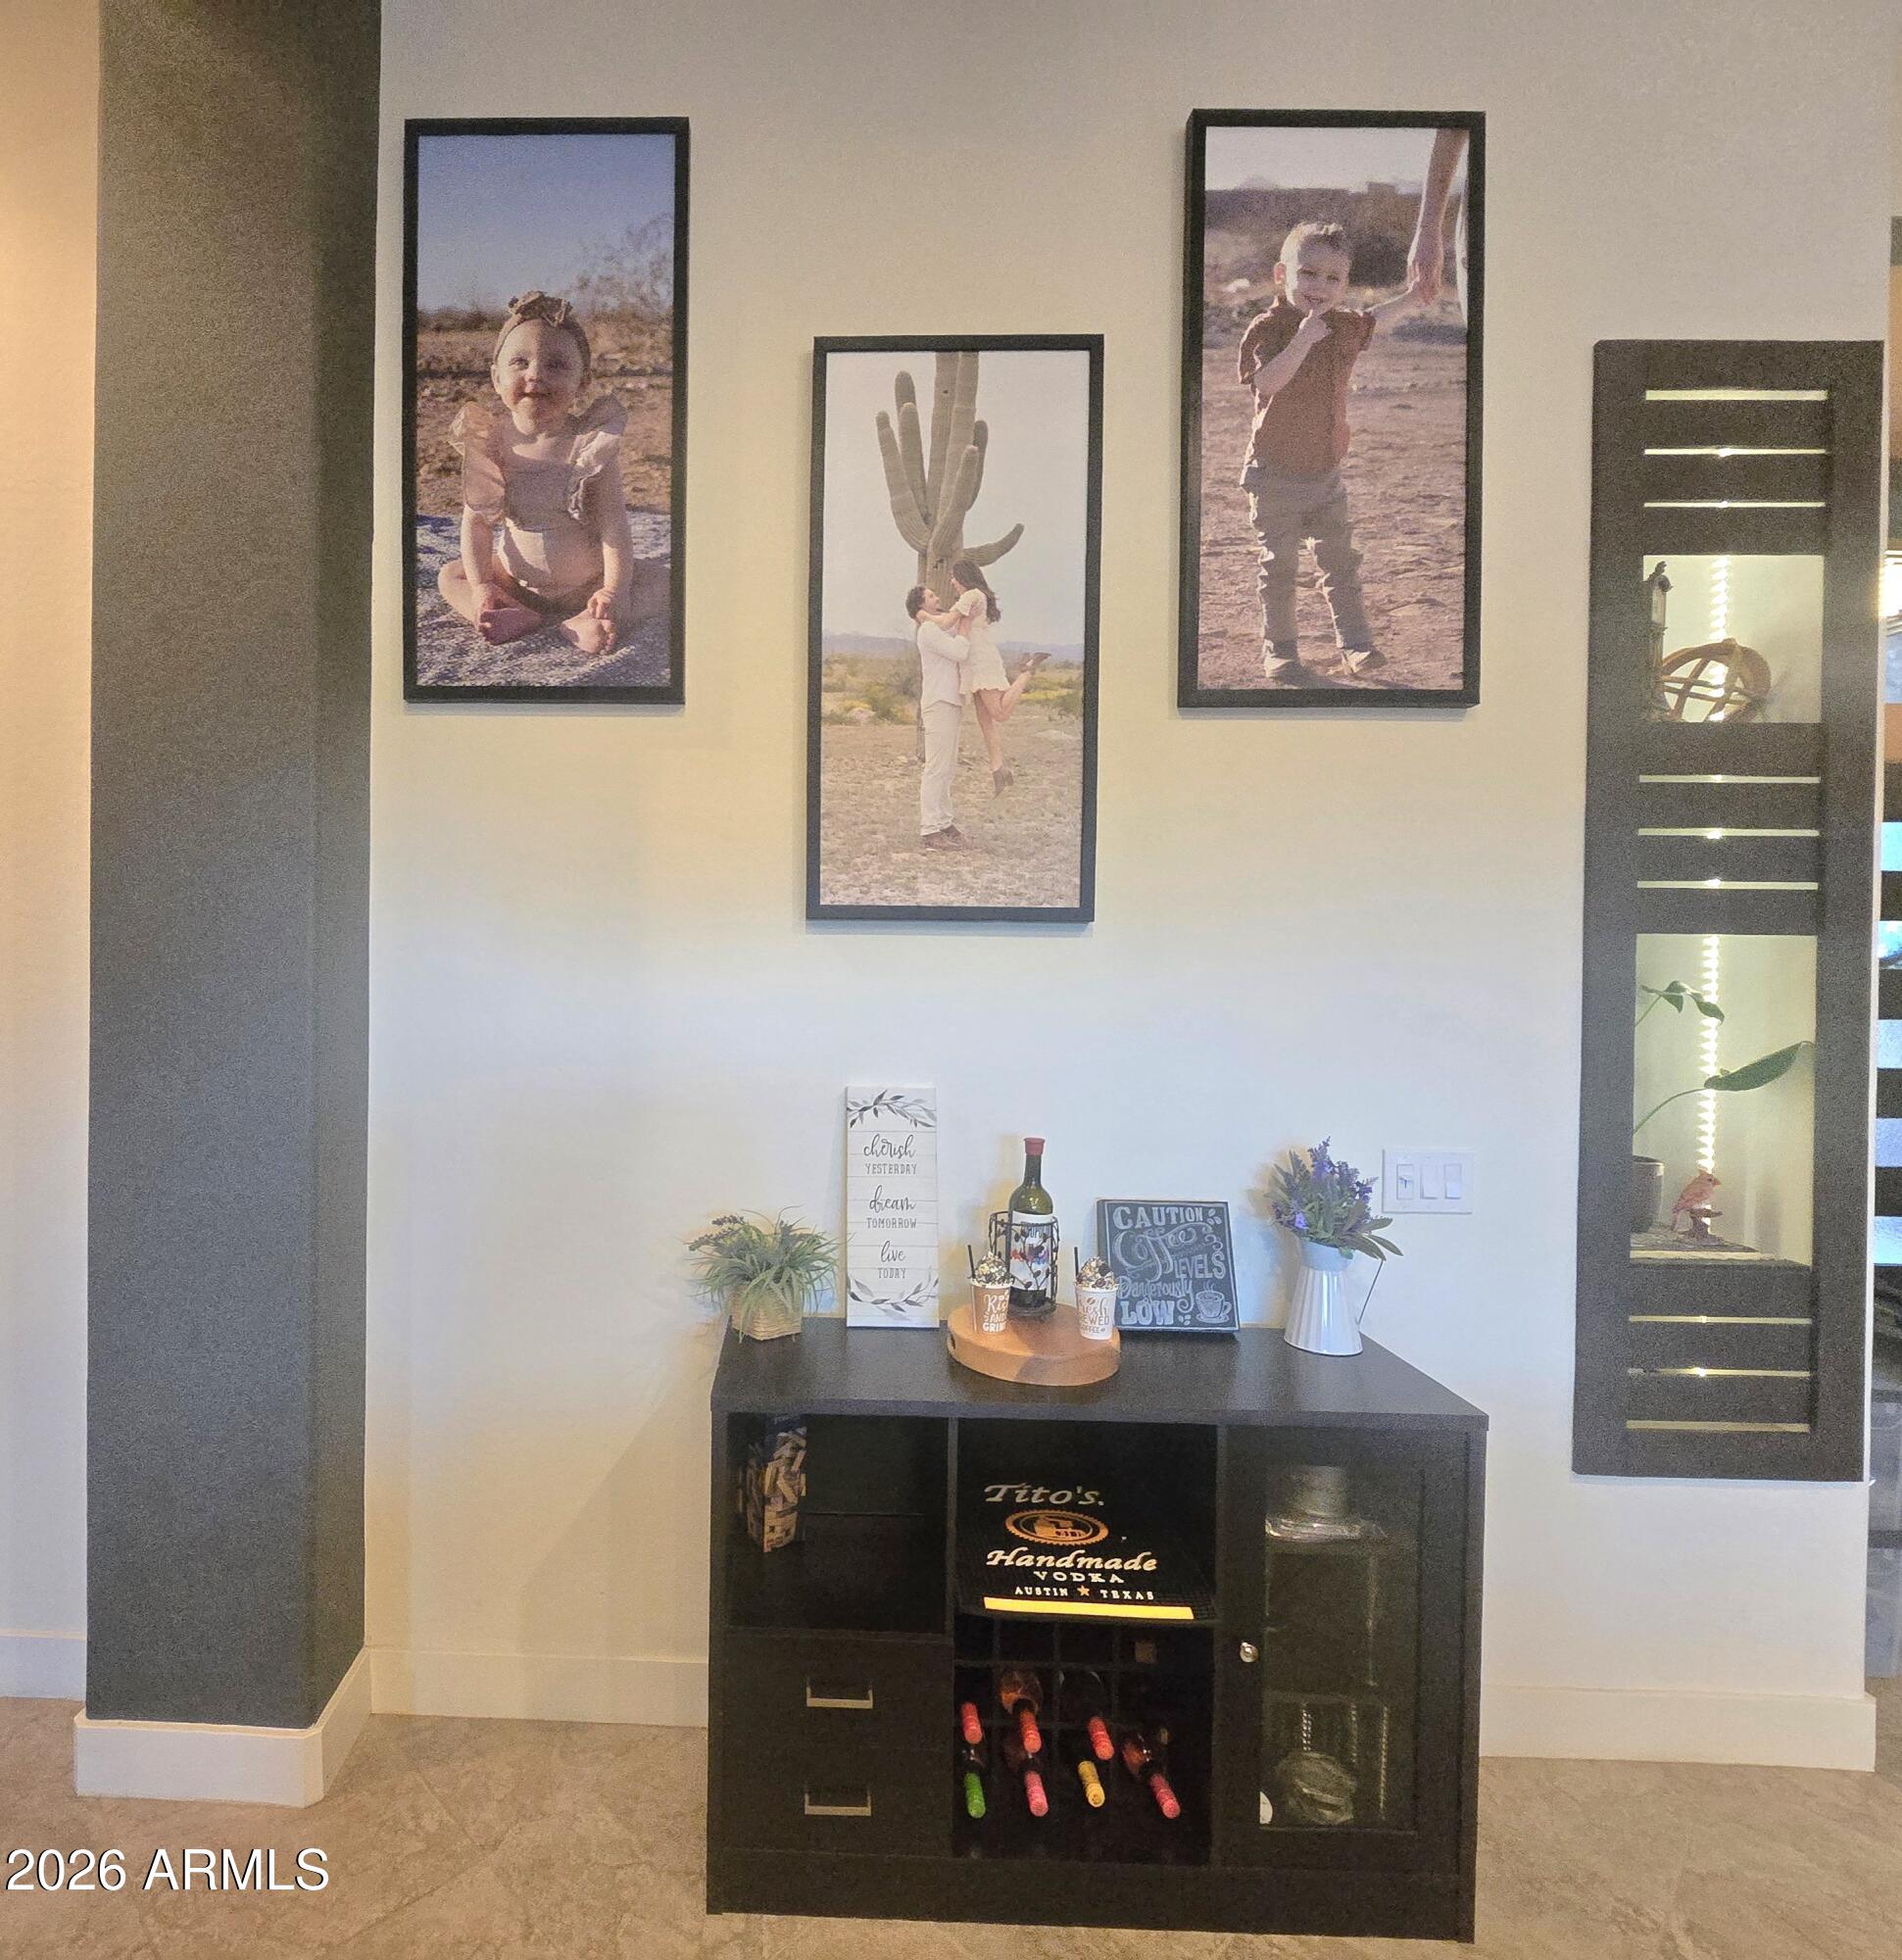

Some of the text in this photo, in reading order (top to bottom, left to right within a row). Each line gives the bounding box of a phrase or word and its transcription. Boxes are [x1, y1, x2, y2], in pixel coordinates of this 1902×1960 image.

[863, 1134, 915, 1158] cherish
[865, 1163, 917, 1175] YESTERDAY
[869, 1185, 915, 1213] dream
[867, 1217, 917, 1229] TOMORROW
[1112, 1206, 1203, 1230] CAUTION
[880, 1240, 905, 1263] live
[1113, 1223, 1211, 1282] Coffee
[878, 1267, 906, 1279] TODAY
[1176, 1250, 1225, 1279] LEVELS
[983, 1294, 1008, 1314] Ris
[1117, 1275, 1195, 1313] Dangerously
[1120, 1299, 1175, 1325] LOW
[982, 1321, 1006, 1333] GRI
[986, 1546, 1158, 1572] Handmade
[1033, 1571, 1125, 1584] VODKA
[1014, 1586, 1155, 1600] AUSTIN TEXAS
